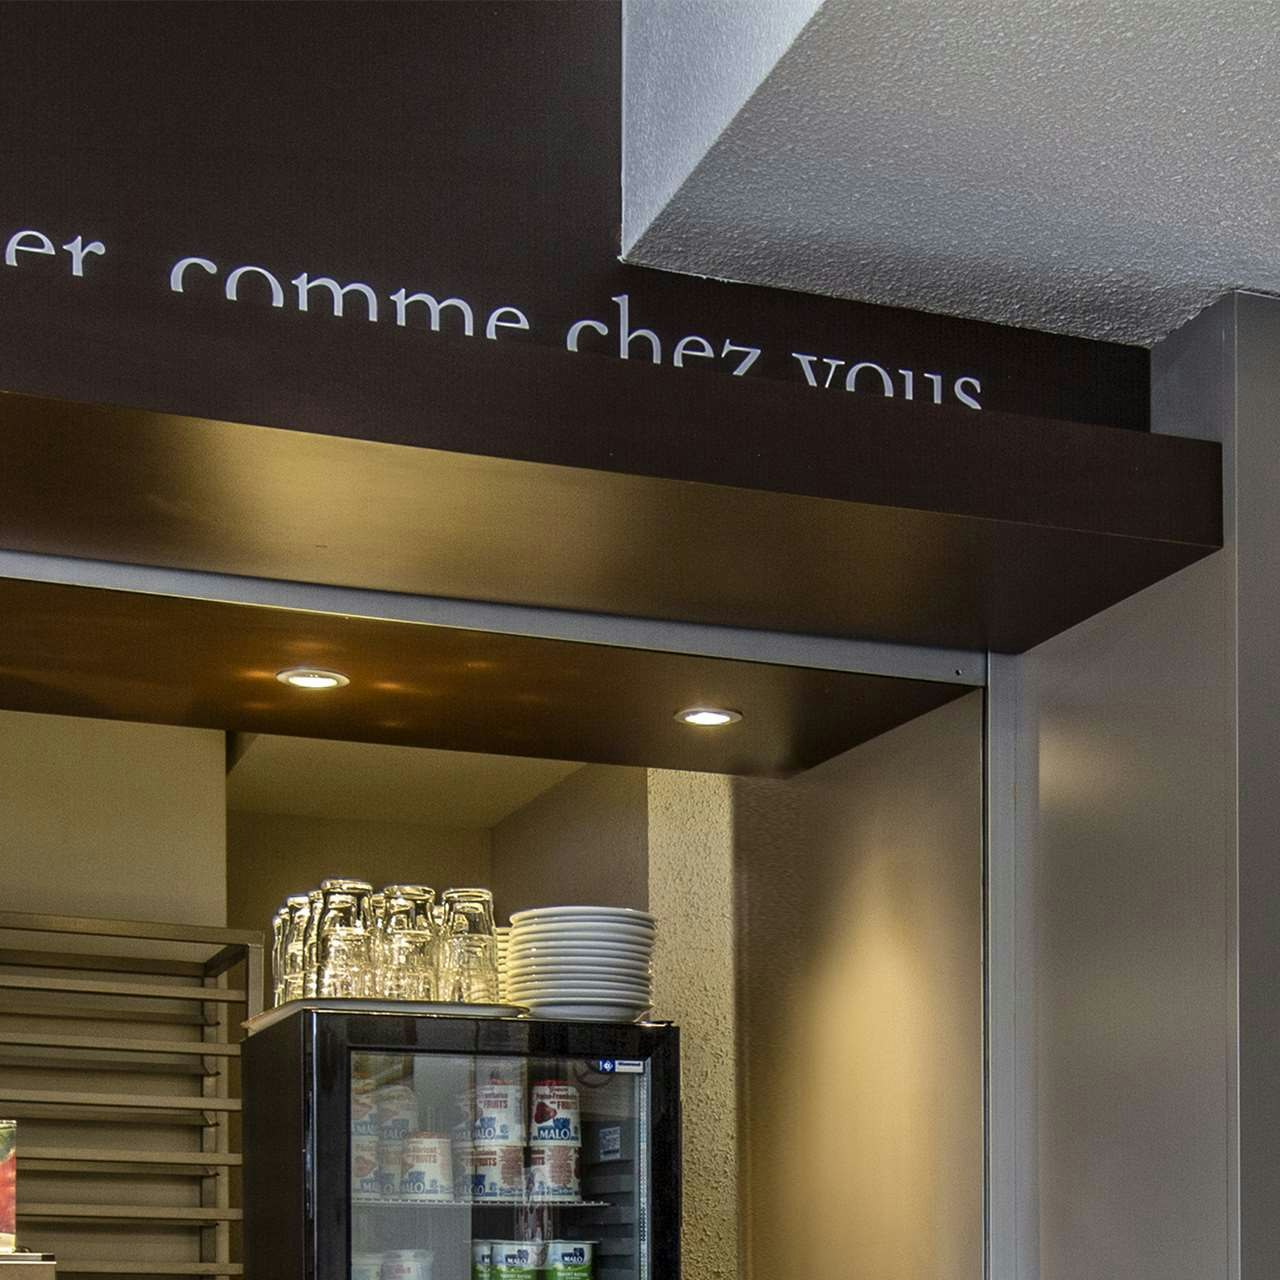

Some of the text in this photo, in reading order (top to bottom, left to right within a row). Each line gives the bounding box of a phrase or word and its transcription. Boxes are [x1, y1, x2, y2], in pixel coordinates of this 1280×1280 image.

[171, 258, 530, 340] comme
[567, 295, 761, 376] chez
[540, 1130, 570, 1139] MALO
